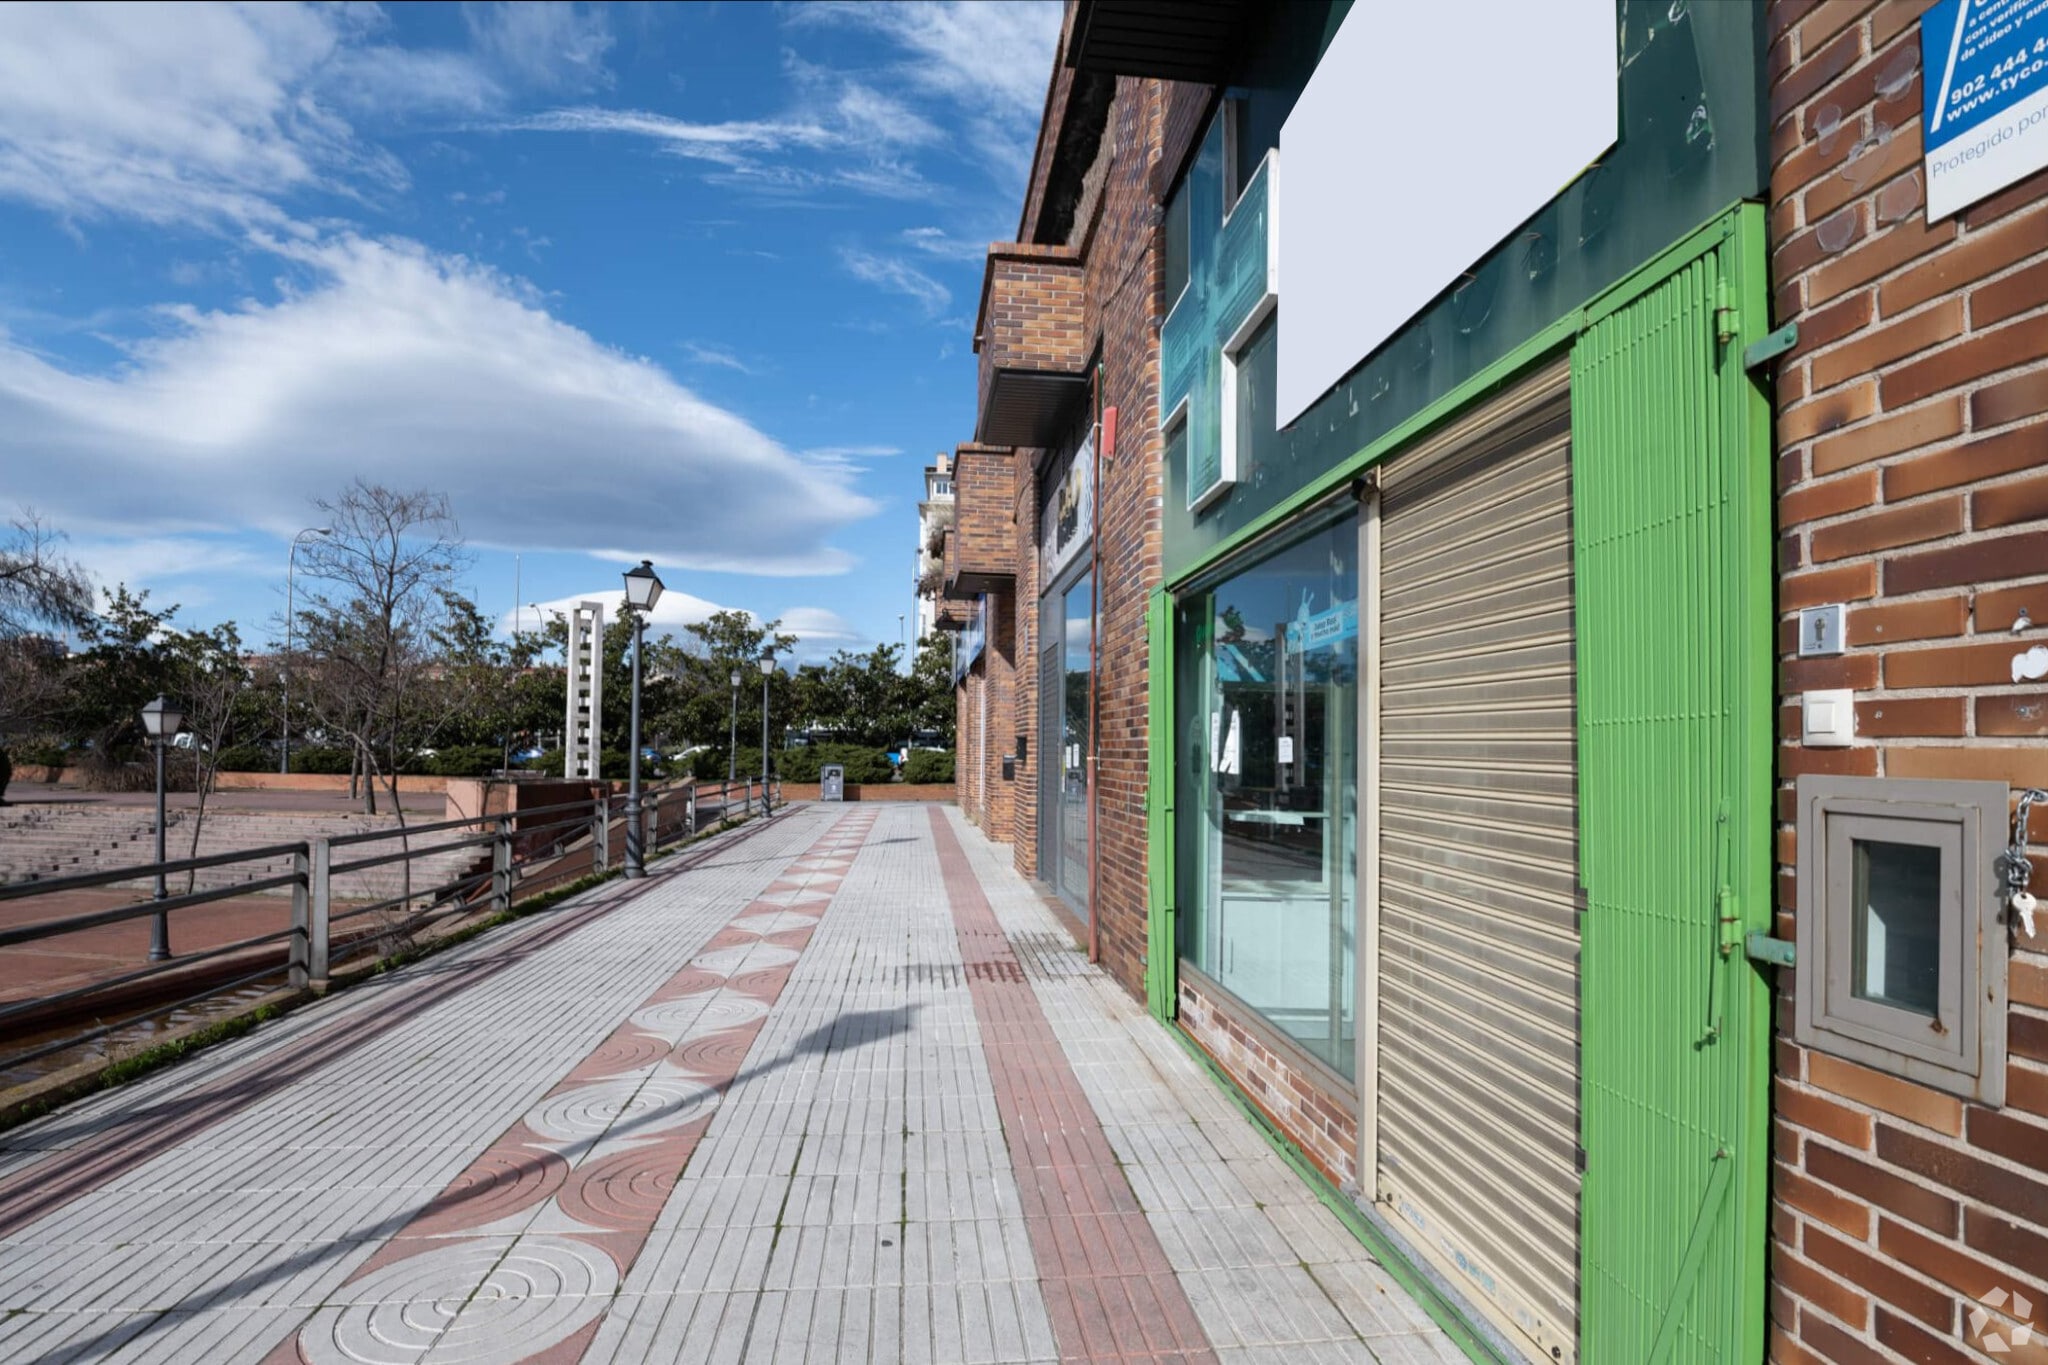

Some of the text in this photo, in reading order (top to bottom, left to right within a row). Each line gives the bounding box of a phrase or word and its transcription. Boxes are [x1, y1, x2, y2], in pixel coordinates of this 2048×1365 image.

[1965, 25, 1987, 45] con
[1951, 36, 2048, 105] 902 444 4
[1932, 104, 2048, 178] Protegido por
